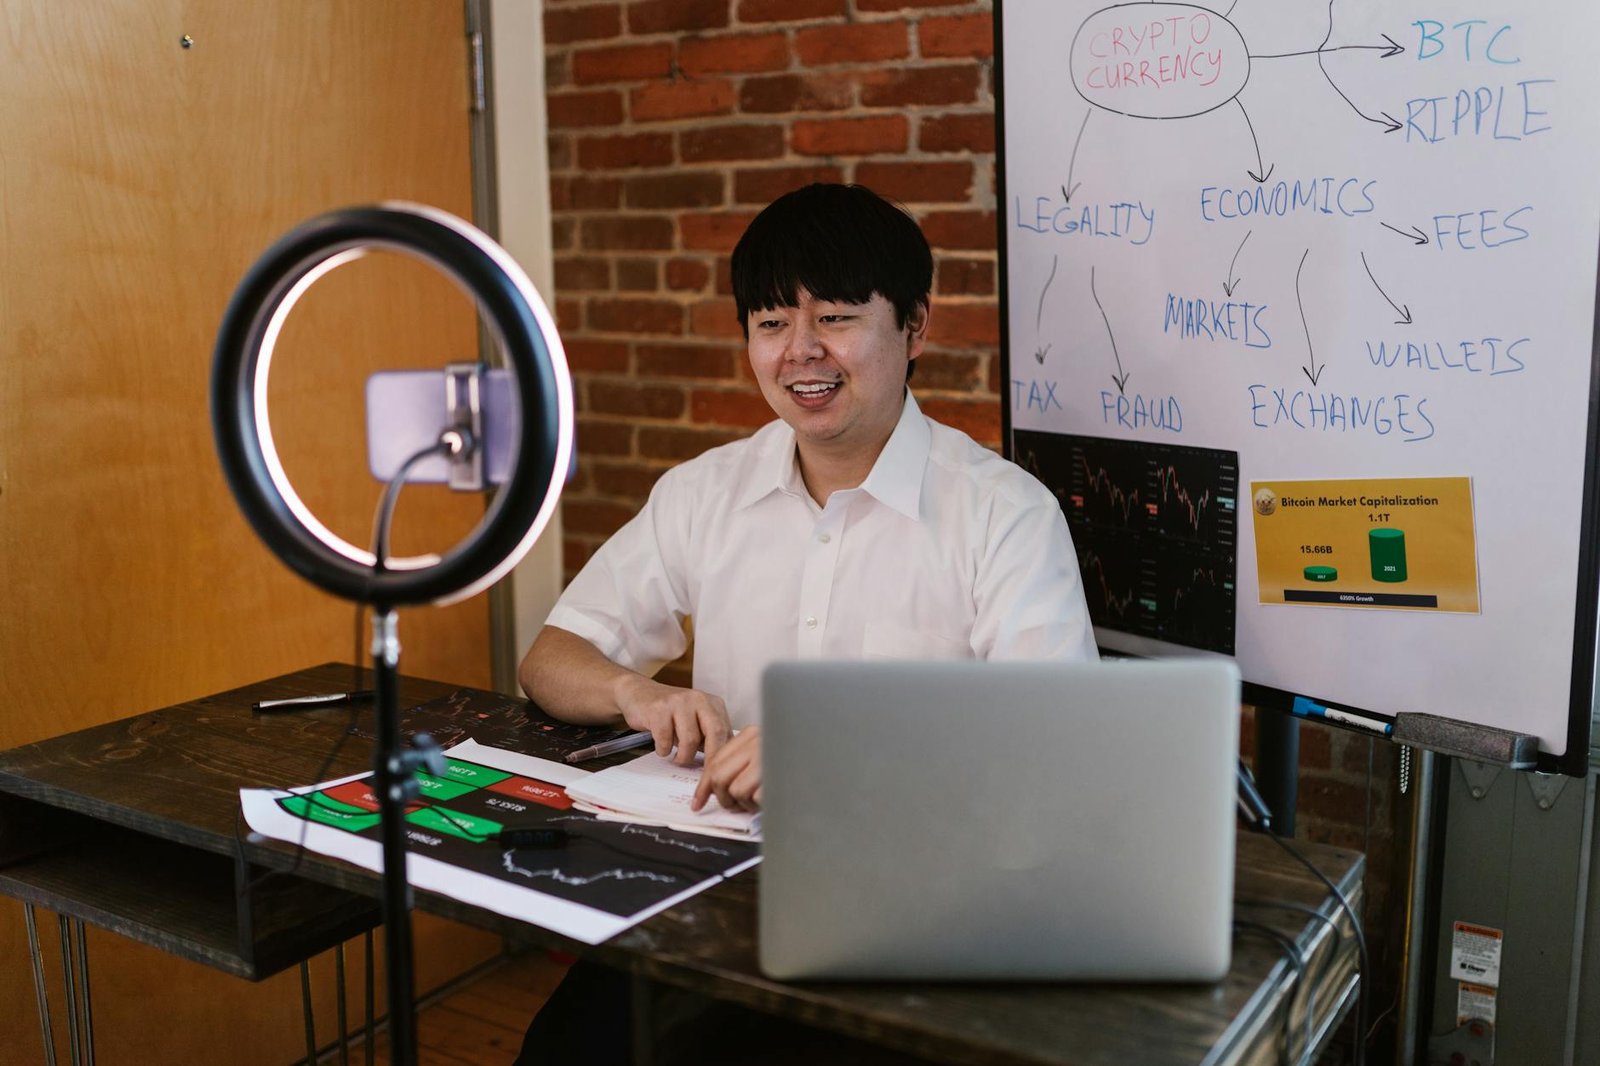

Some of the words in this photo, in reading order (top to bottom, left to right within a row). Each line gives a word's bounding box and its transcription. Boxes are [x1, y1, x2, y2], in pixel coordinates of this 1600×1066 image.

[1089, 13, 1211, 58] CRYPTO
[1411, 20, 1521, 64] BTC
[1086, 46, 1222, 88] CURRENCY
[1405, 79, 1557, 143] RIPPLE
[1016, 196, 1154, 245] LEGALITY
[1201, 178, 1377, 222] ECONOMICS
[1433, 206, 1534, 250] FEES
[1164, 293, 1272, 348] MARKETS
[1366, 337, 1531, 376] WALLETS
[1012, 379, 1063, 414] TAX
[1101, 391, 1183, 432] FRAUD
[1248, 384, 1435, 442] EXCHANGES
[1281, 497, 1315, 508] Bitcoin
[1318, 496, 1357, 507] Market
[1359, 495, 1439, 507] Capitalization
[1368, 513, 1391, 523] 1.1T
[1300, 545, 1333, 554] 15.66B
